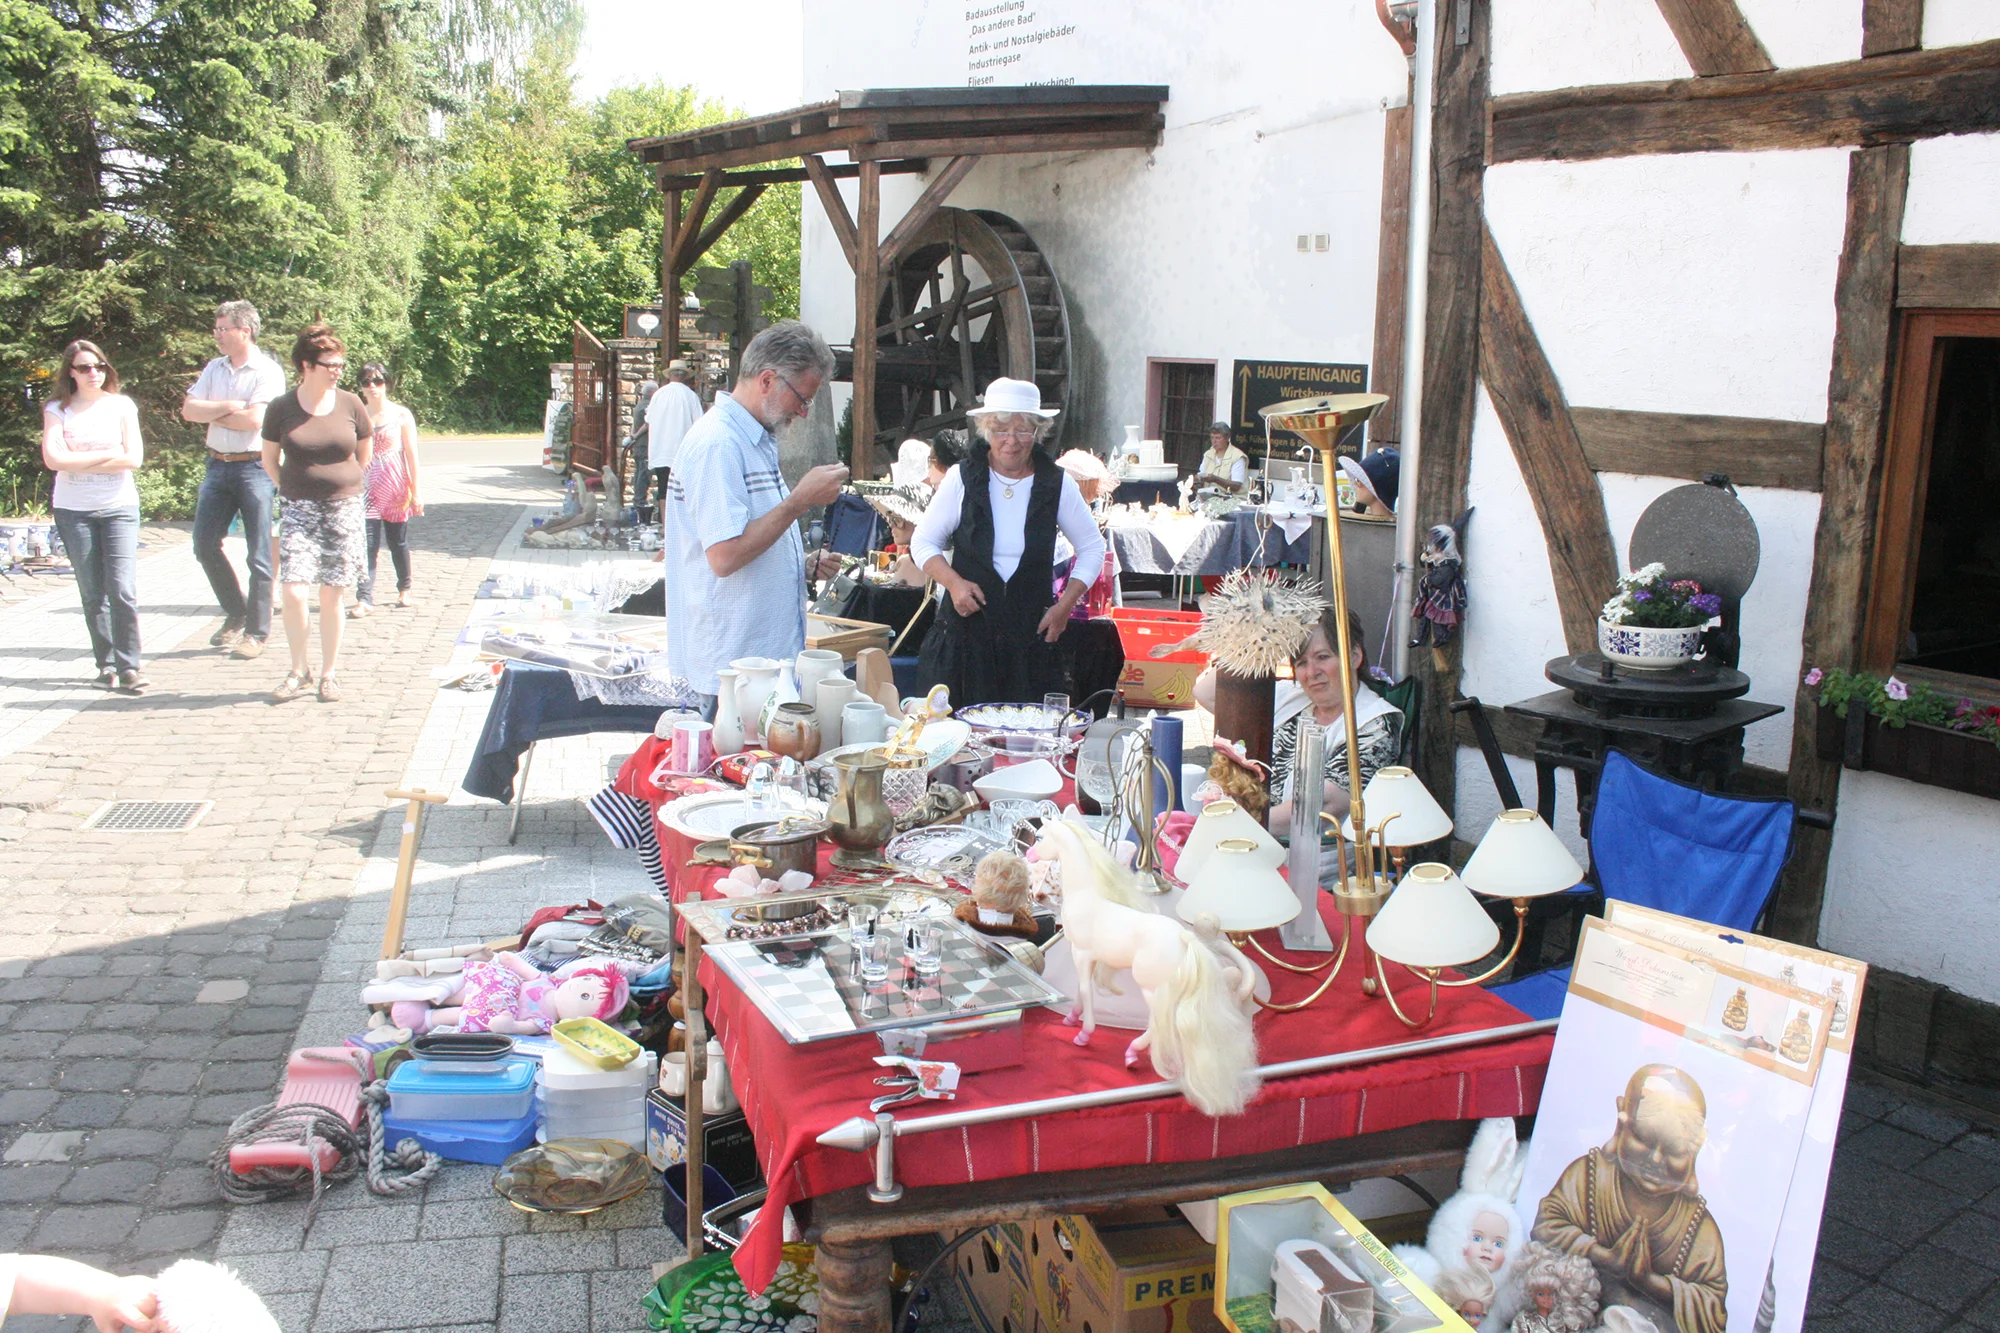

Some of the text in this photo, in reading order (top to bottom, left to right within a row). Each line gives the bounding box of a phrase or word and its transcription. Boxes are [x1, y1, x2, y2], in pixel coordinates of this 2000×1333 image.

[965, 0, 1025, 21] Badausstellung
[988, 18, 1015, 32] andere
[968, 24, 1076, 55] Antik- und Nostalgiebäder
[968, 53, 1021, 71] Industriegase
[968, 75, 994, 87] Fliesen
[1257, 364, 1361, 384] HAUPTEINGANG
[1249, 434, 1288, 447] Führngen
[1248, 447, 1289, 459] Anmdung
